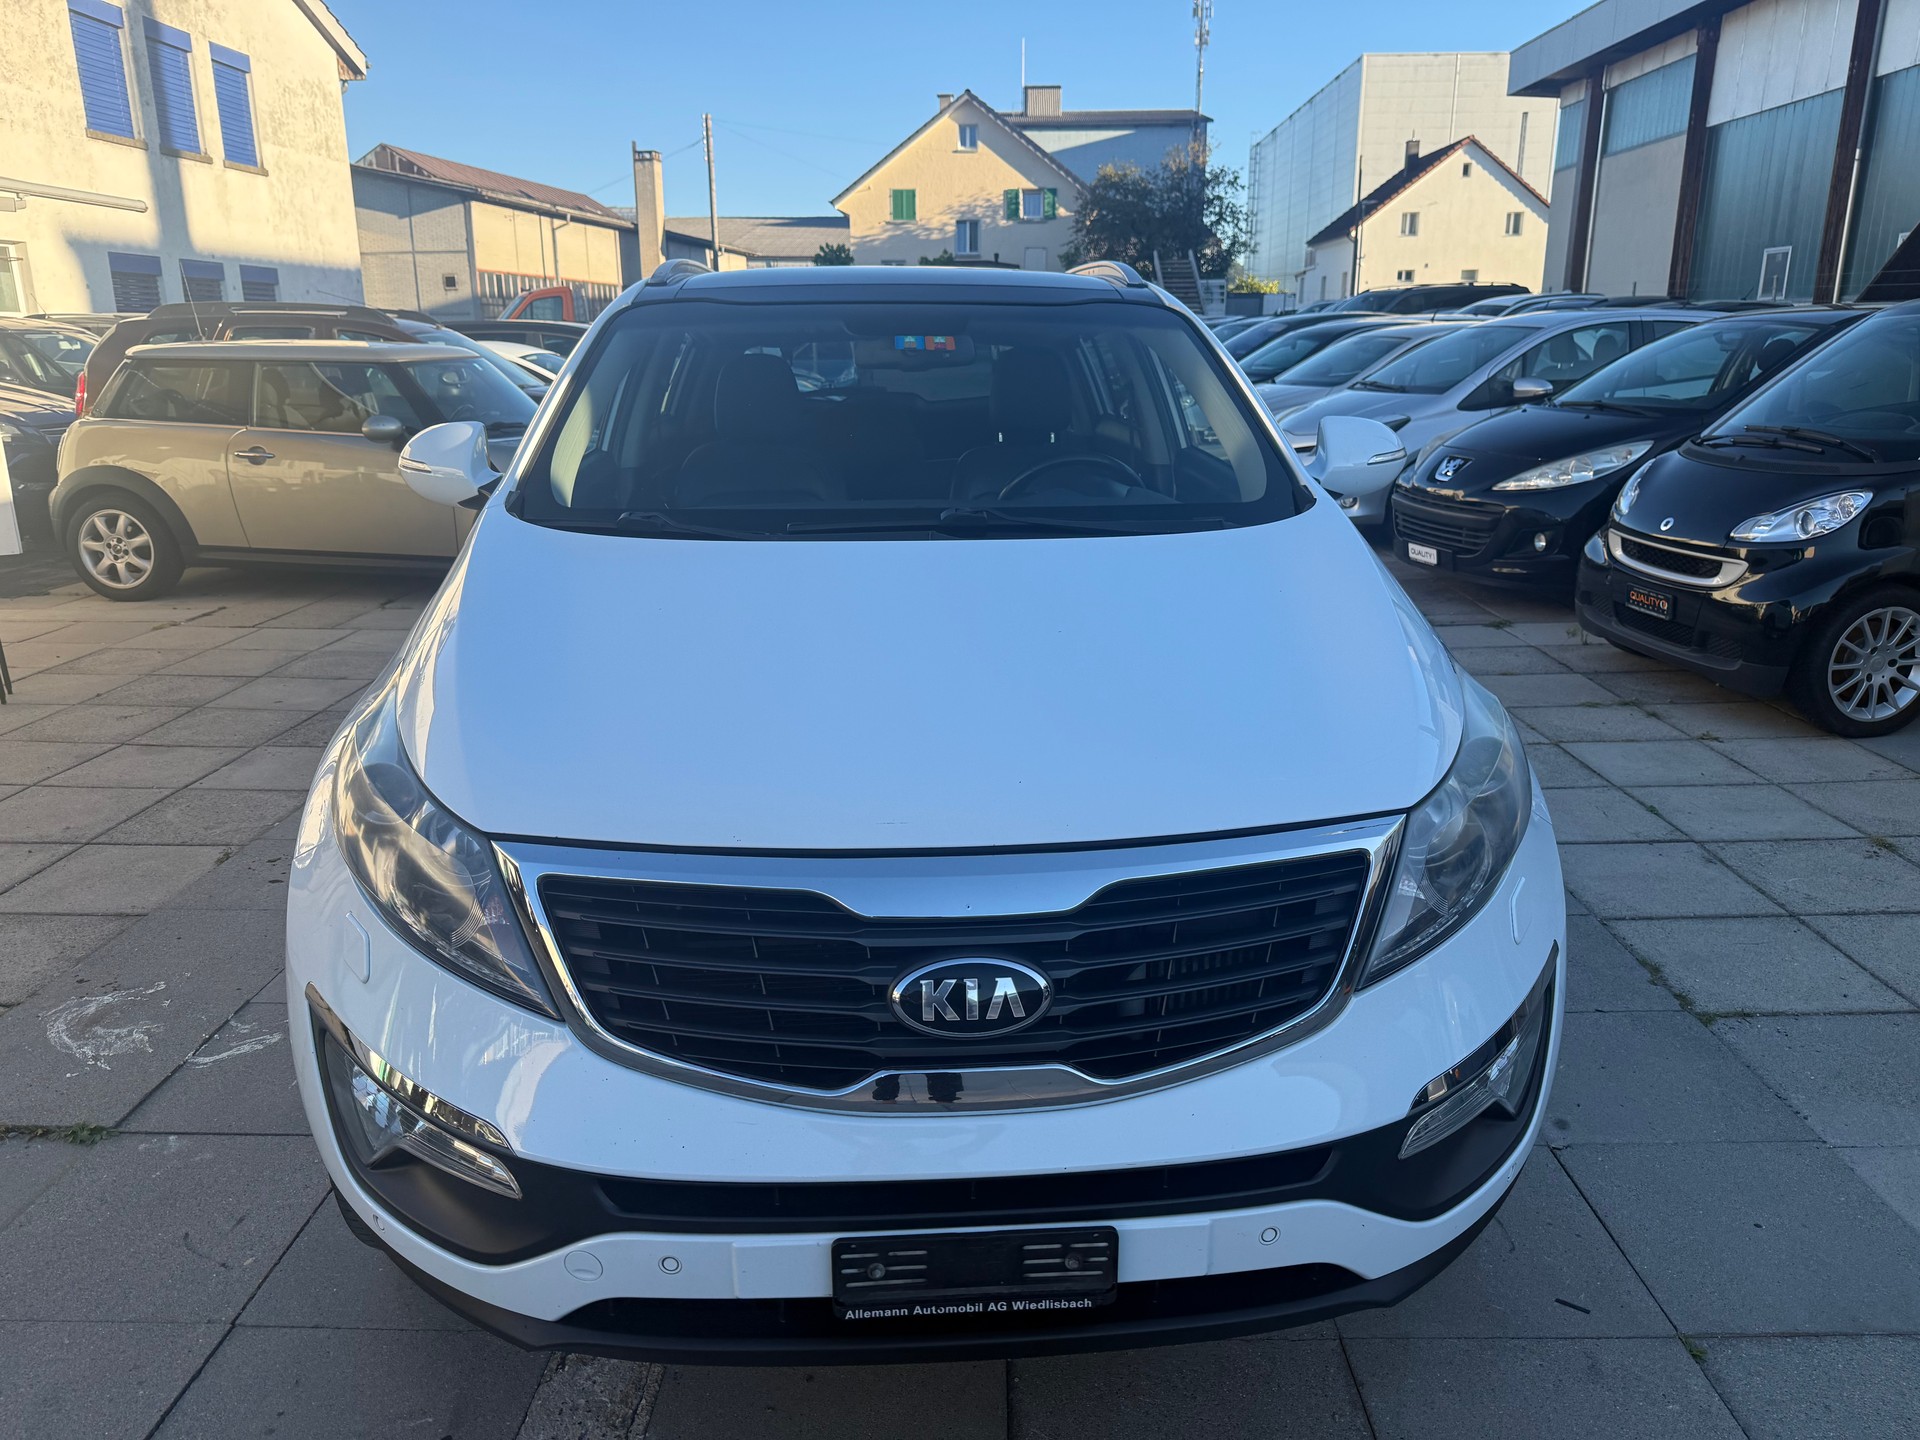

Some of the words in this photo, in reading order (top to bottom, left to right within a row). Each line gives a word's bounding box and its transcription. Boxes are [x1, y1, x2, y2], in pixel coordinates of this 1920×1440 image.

[920, 977, 1026, 1022] KIA
[845, 1307, 909, 1320] Allemann
[913, 1303, 983, 1316] Automobil
[987, 1301, 1008, 1312] AG
[1012, 1298, 1093, 1311] Wiedlisbach
